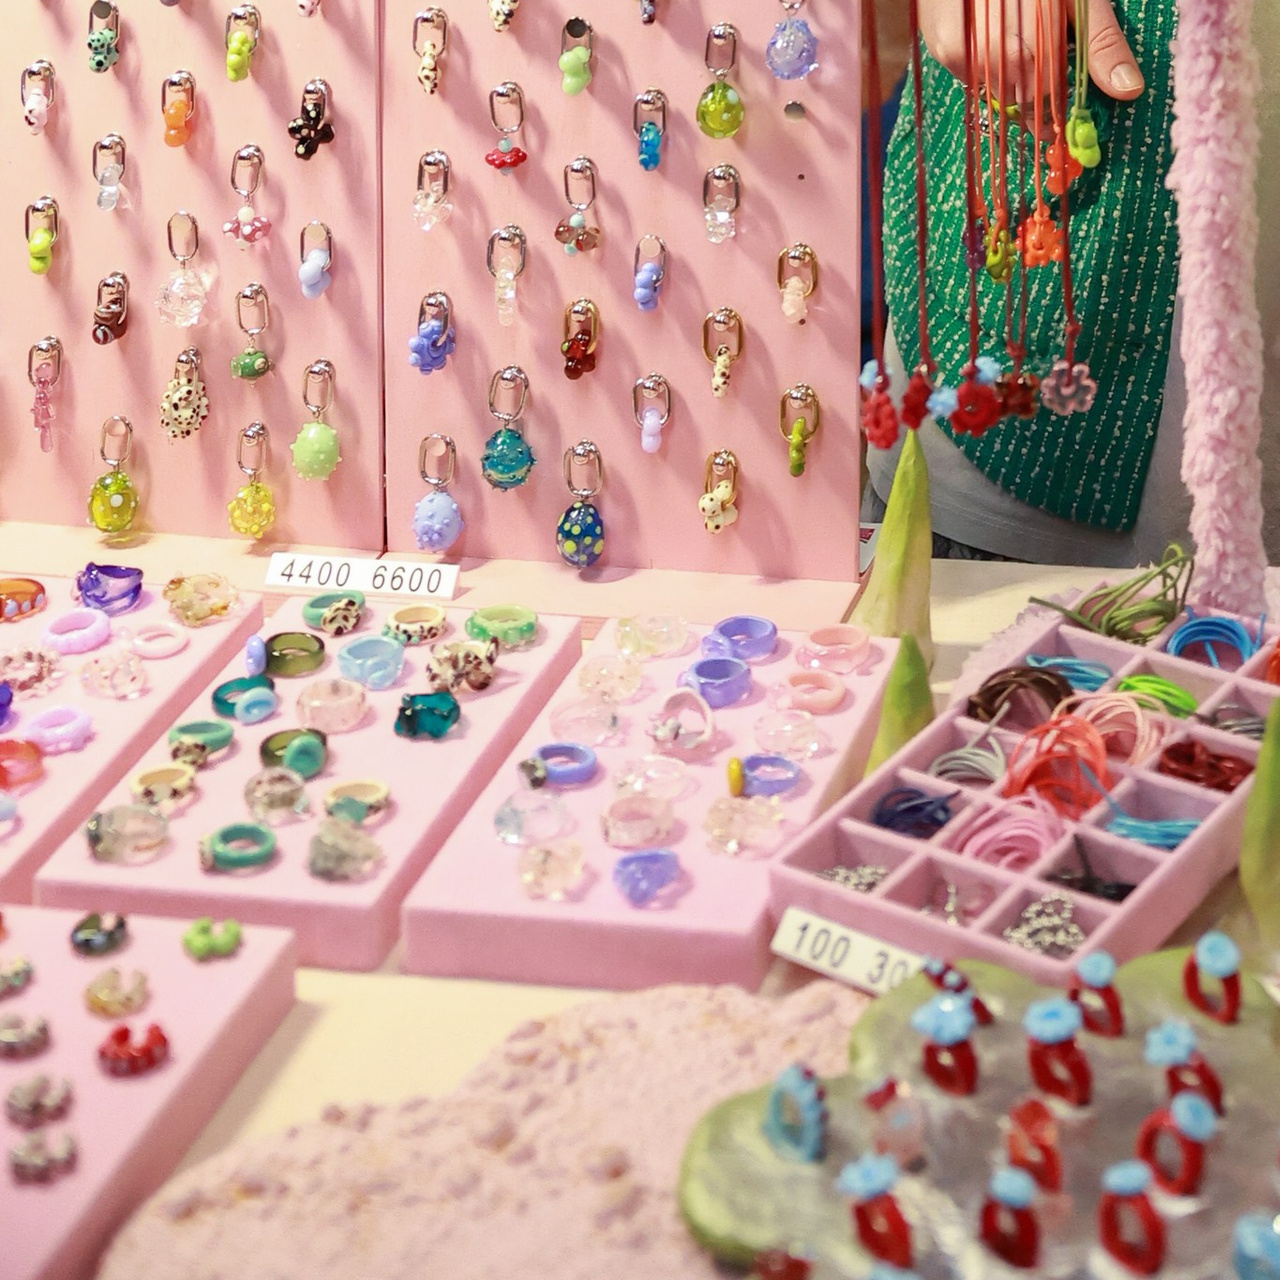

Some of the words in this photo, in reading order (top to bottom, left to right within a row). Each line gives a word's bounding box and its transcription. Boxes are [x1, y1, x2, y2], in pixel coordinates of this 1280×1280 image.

[281, 558, 351, 587] 4400
[372, 565, 442, 593] 6600
[794, 922, 850, 968] 100
